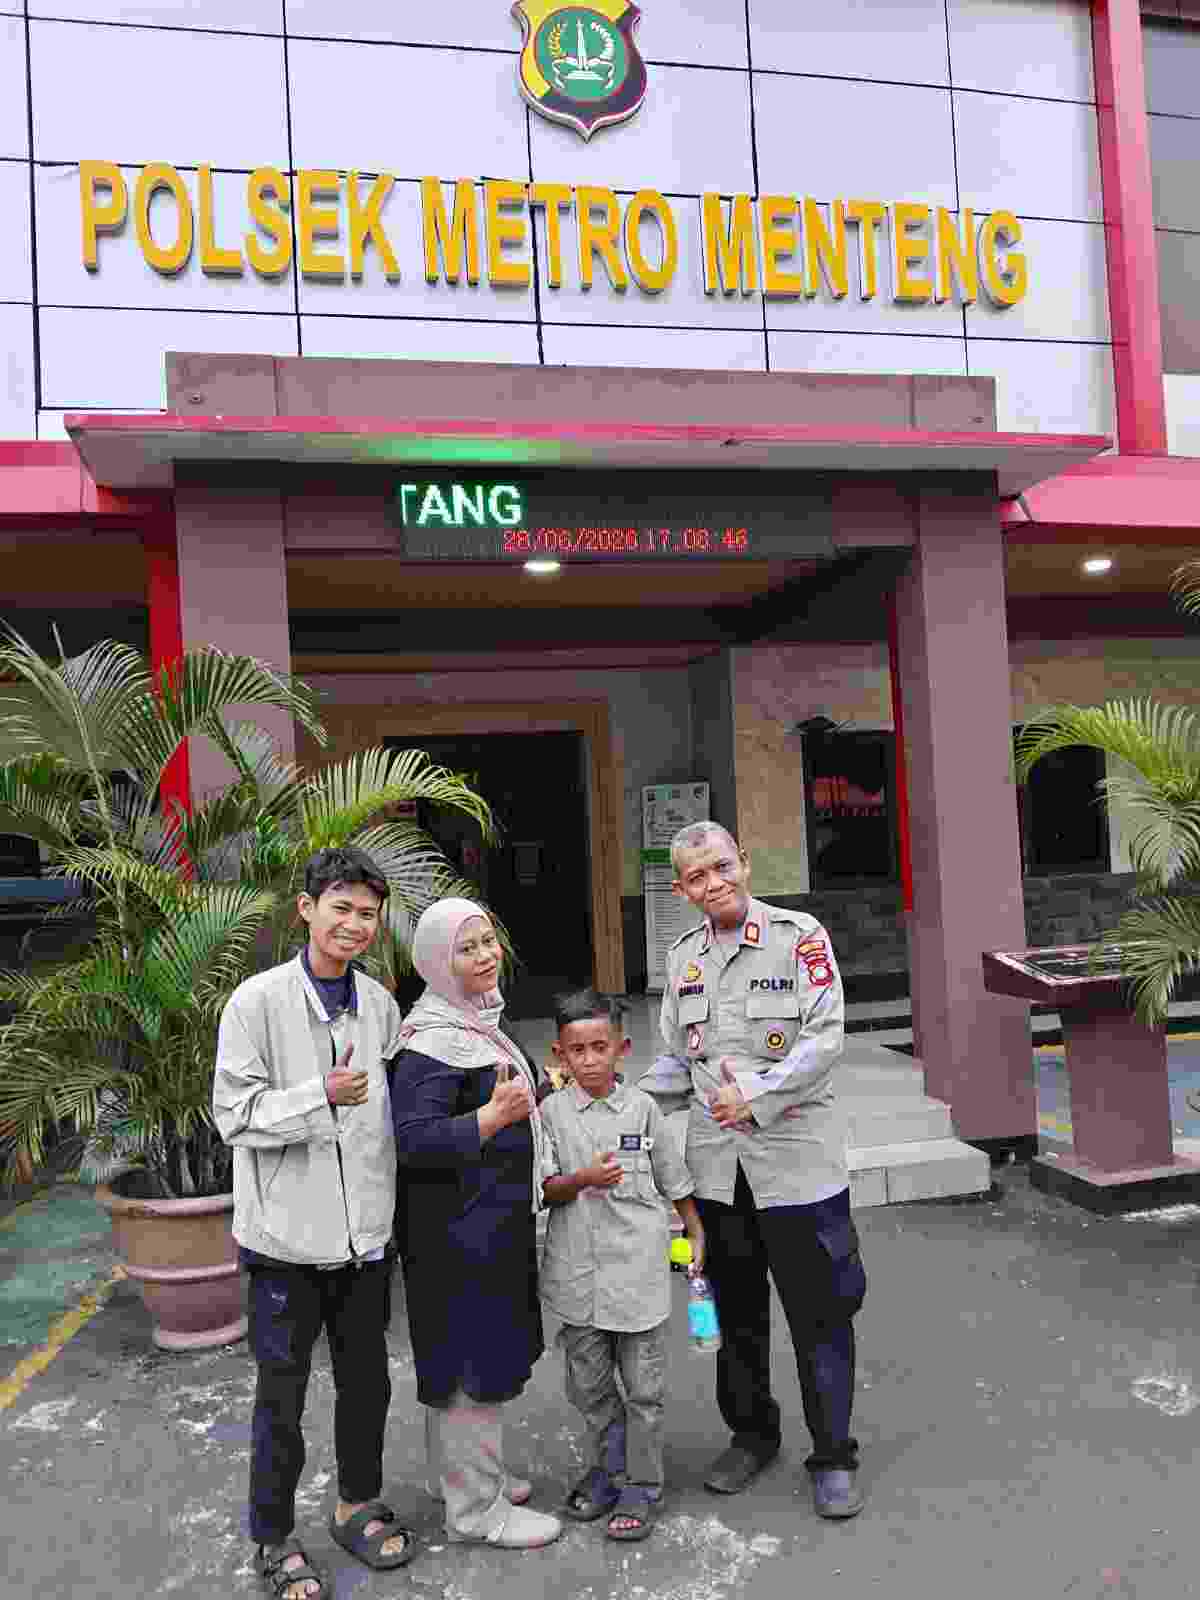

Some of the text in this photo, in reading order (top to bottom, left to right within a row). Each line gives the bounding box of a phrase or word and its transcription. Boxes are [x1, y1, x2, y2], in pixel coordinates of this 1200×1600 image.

[80, 160, 1027, 307] POLSEK METRO MENTENG
[750, 978, 794, 991] POLRI
